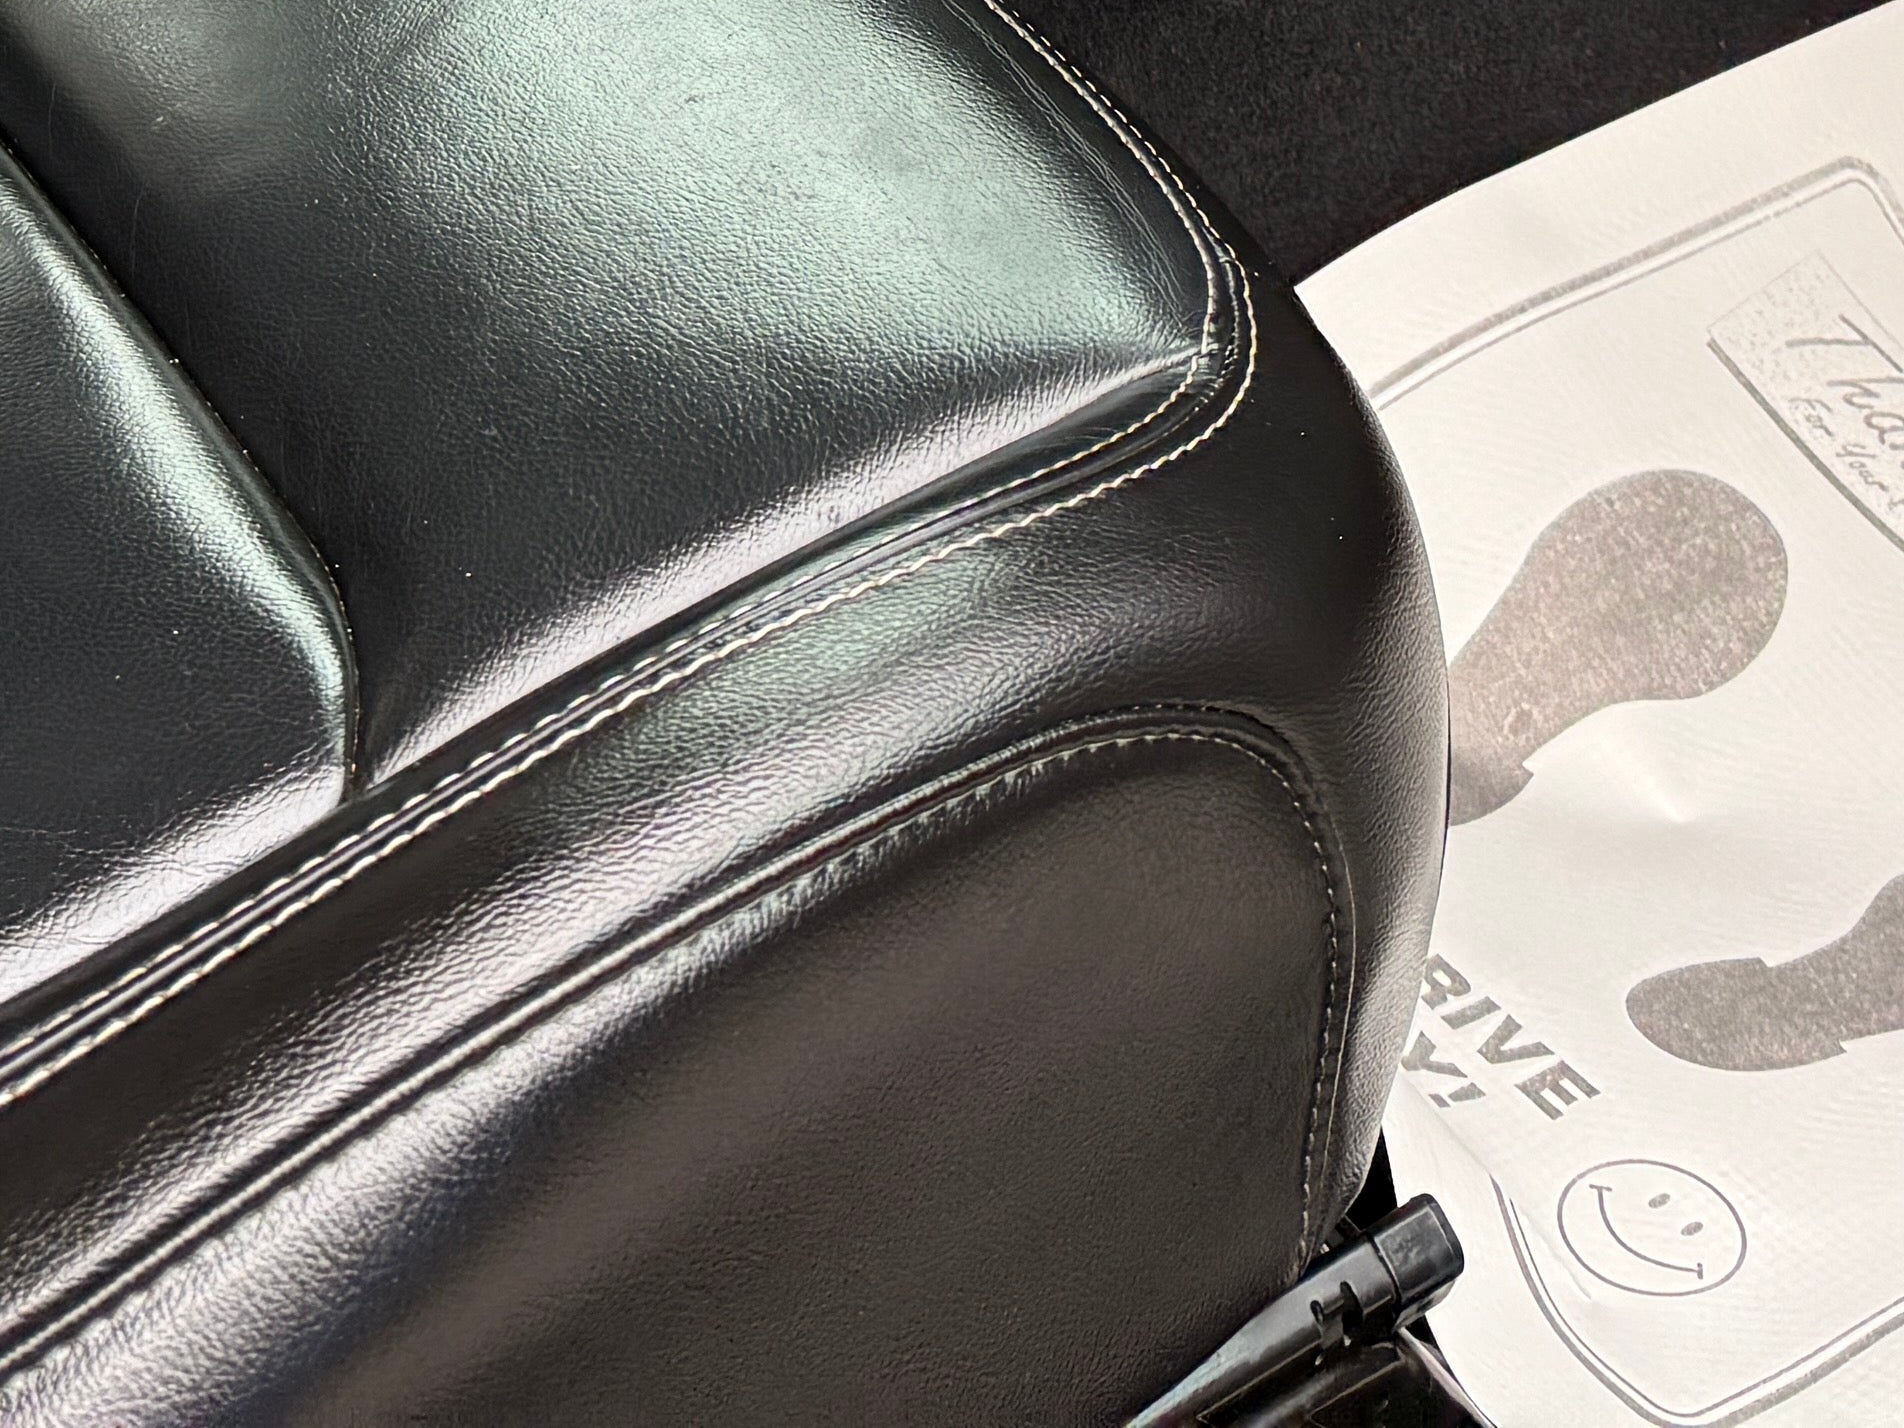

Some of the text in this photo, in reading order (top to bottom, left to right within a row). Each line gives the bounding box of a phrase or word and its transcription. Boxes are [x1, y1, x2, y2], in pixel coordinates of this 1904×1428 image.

[1788, 396, 1835, 438] For
[1835, 443, 1890, 493] Your
[1419, 953, 1602, 1121] RIVE
